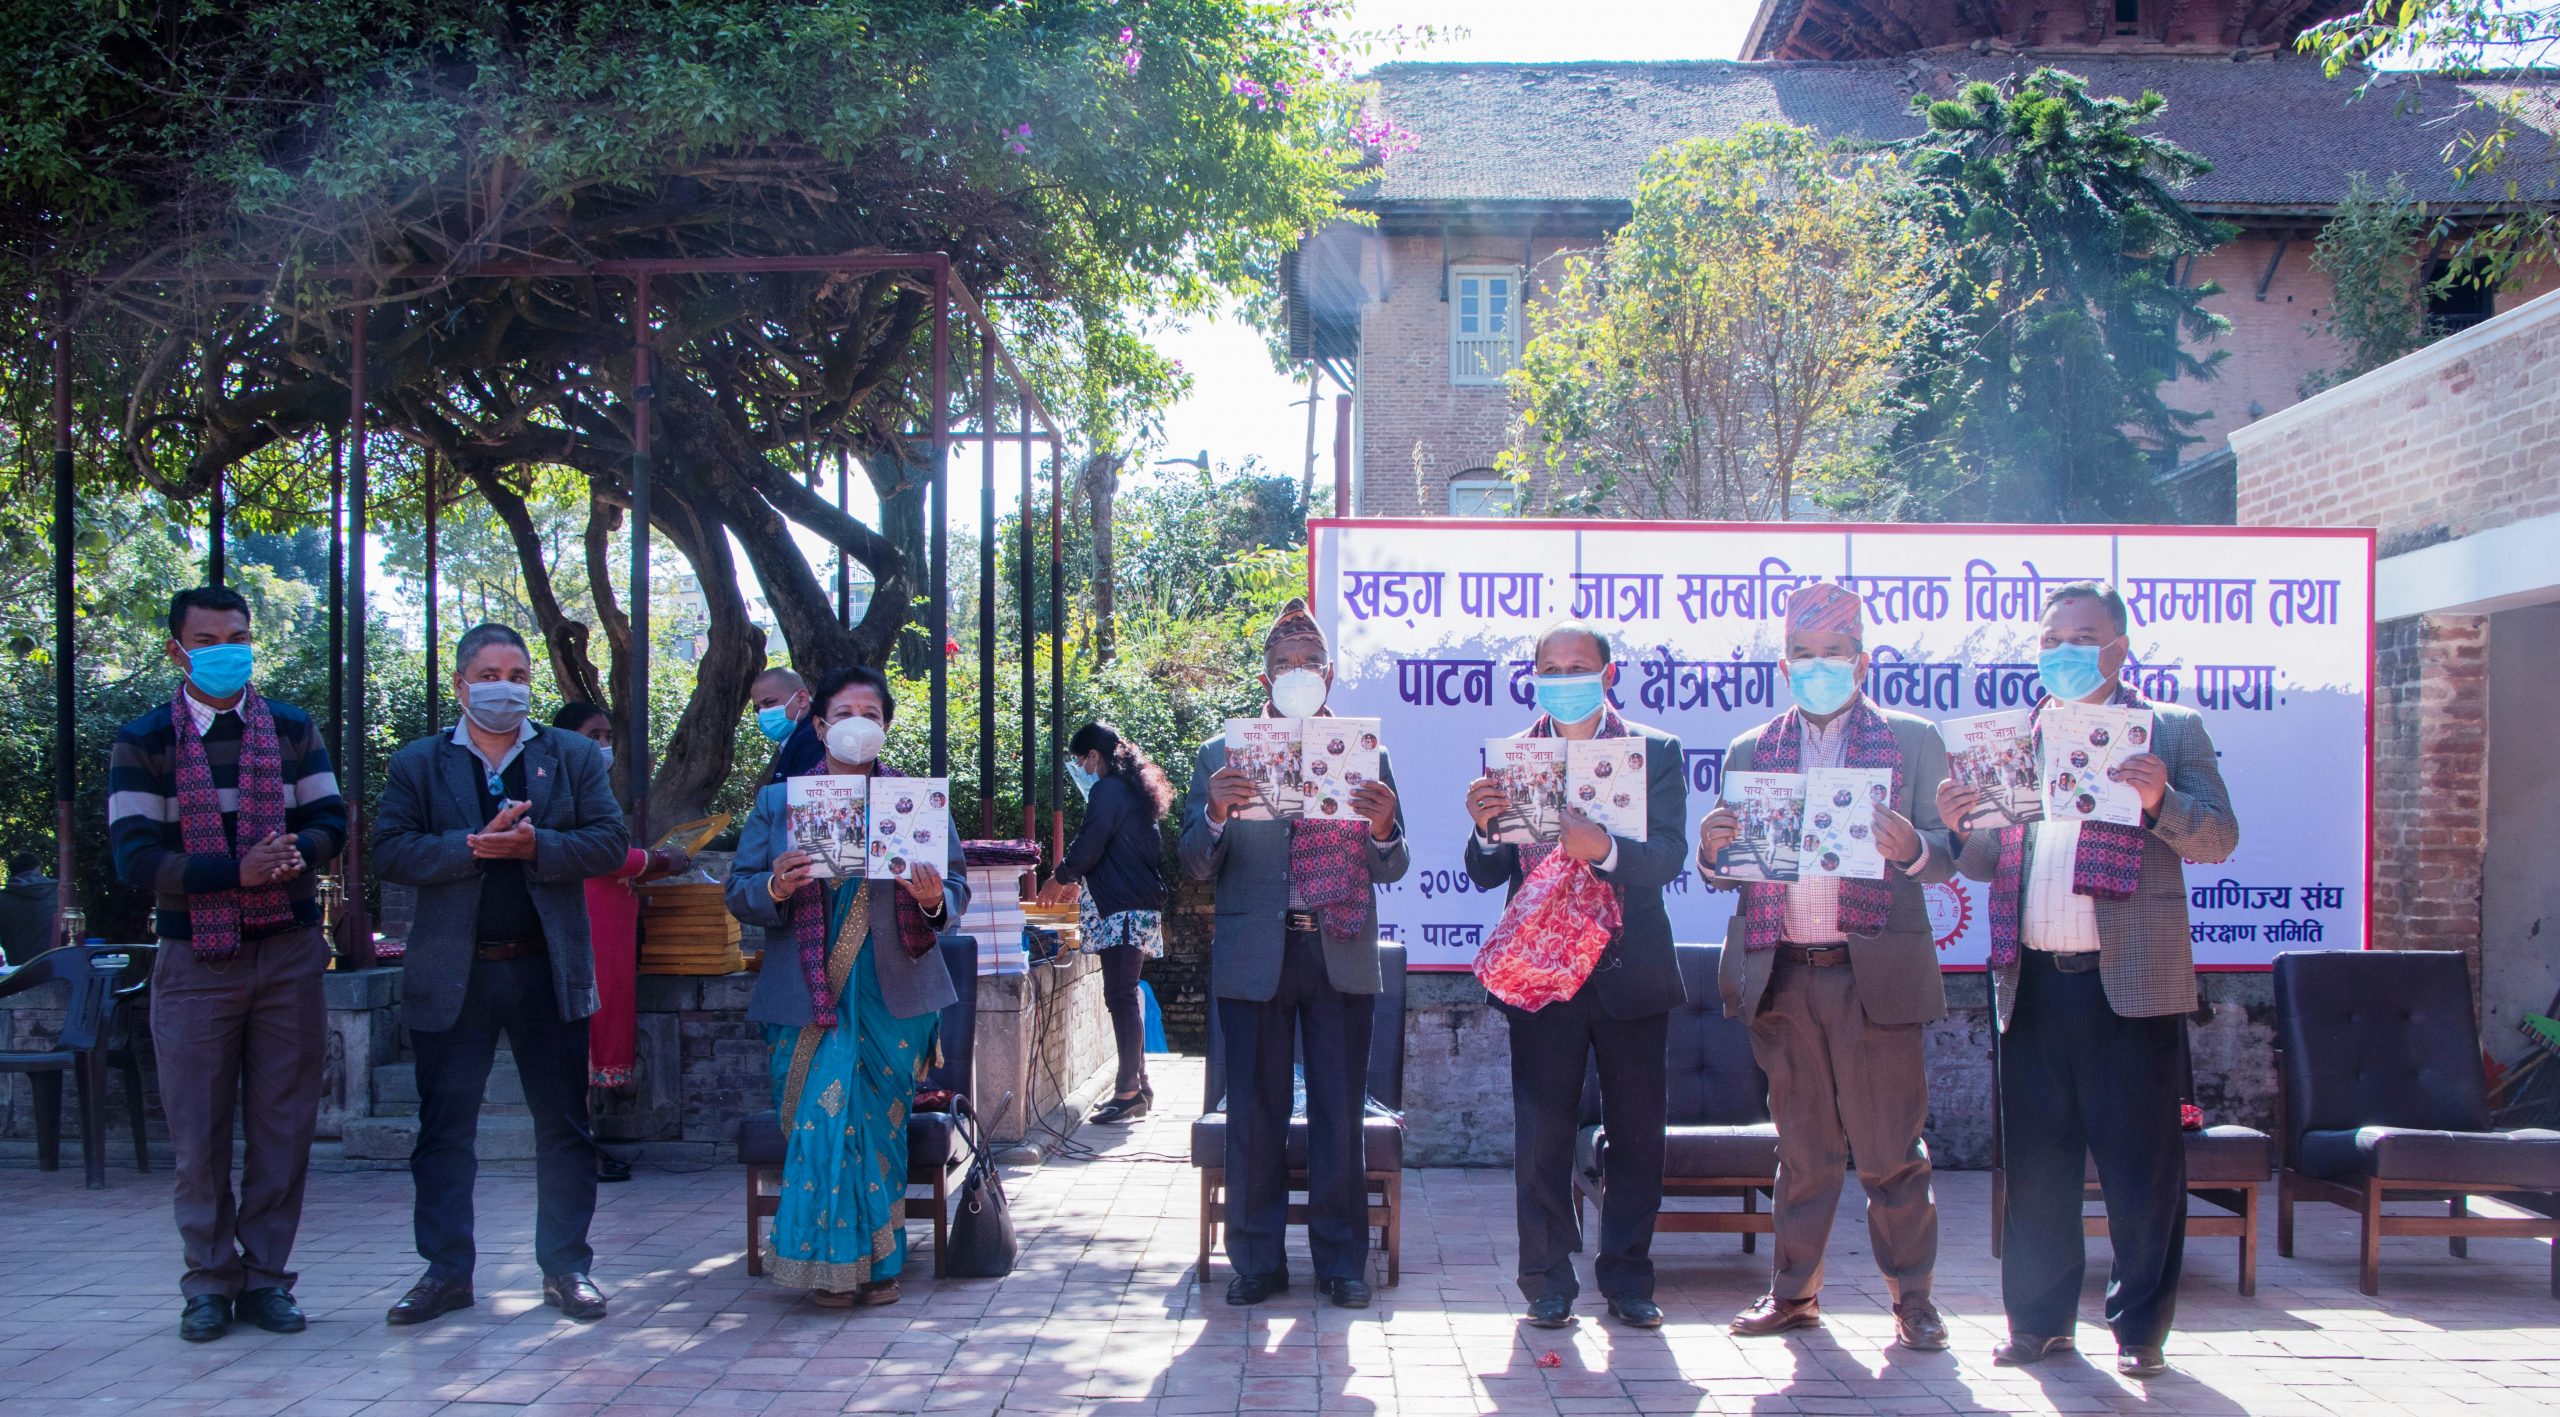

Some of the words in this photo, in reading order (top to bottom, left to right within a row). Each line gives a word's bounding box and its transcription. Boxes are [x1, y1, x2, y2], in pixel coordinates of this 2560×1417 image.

[1569, 572, 1664, 623] जात्रा
[2126, 577, 2257, 628] सम्मान
[2268, 578, 2342, 628] तथा
[1396, 659, 1497, 707] पाटन
[2191, 878, 2293, 910] वाणिज्य
[2300, 881, 2345, 912] संघ
[1421, 923, 1484, 948] पाटन
[2263, 918, 2324, 944] समिति
